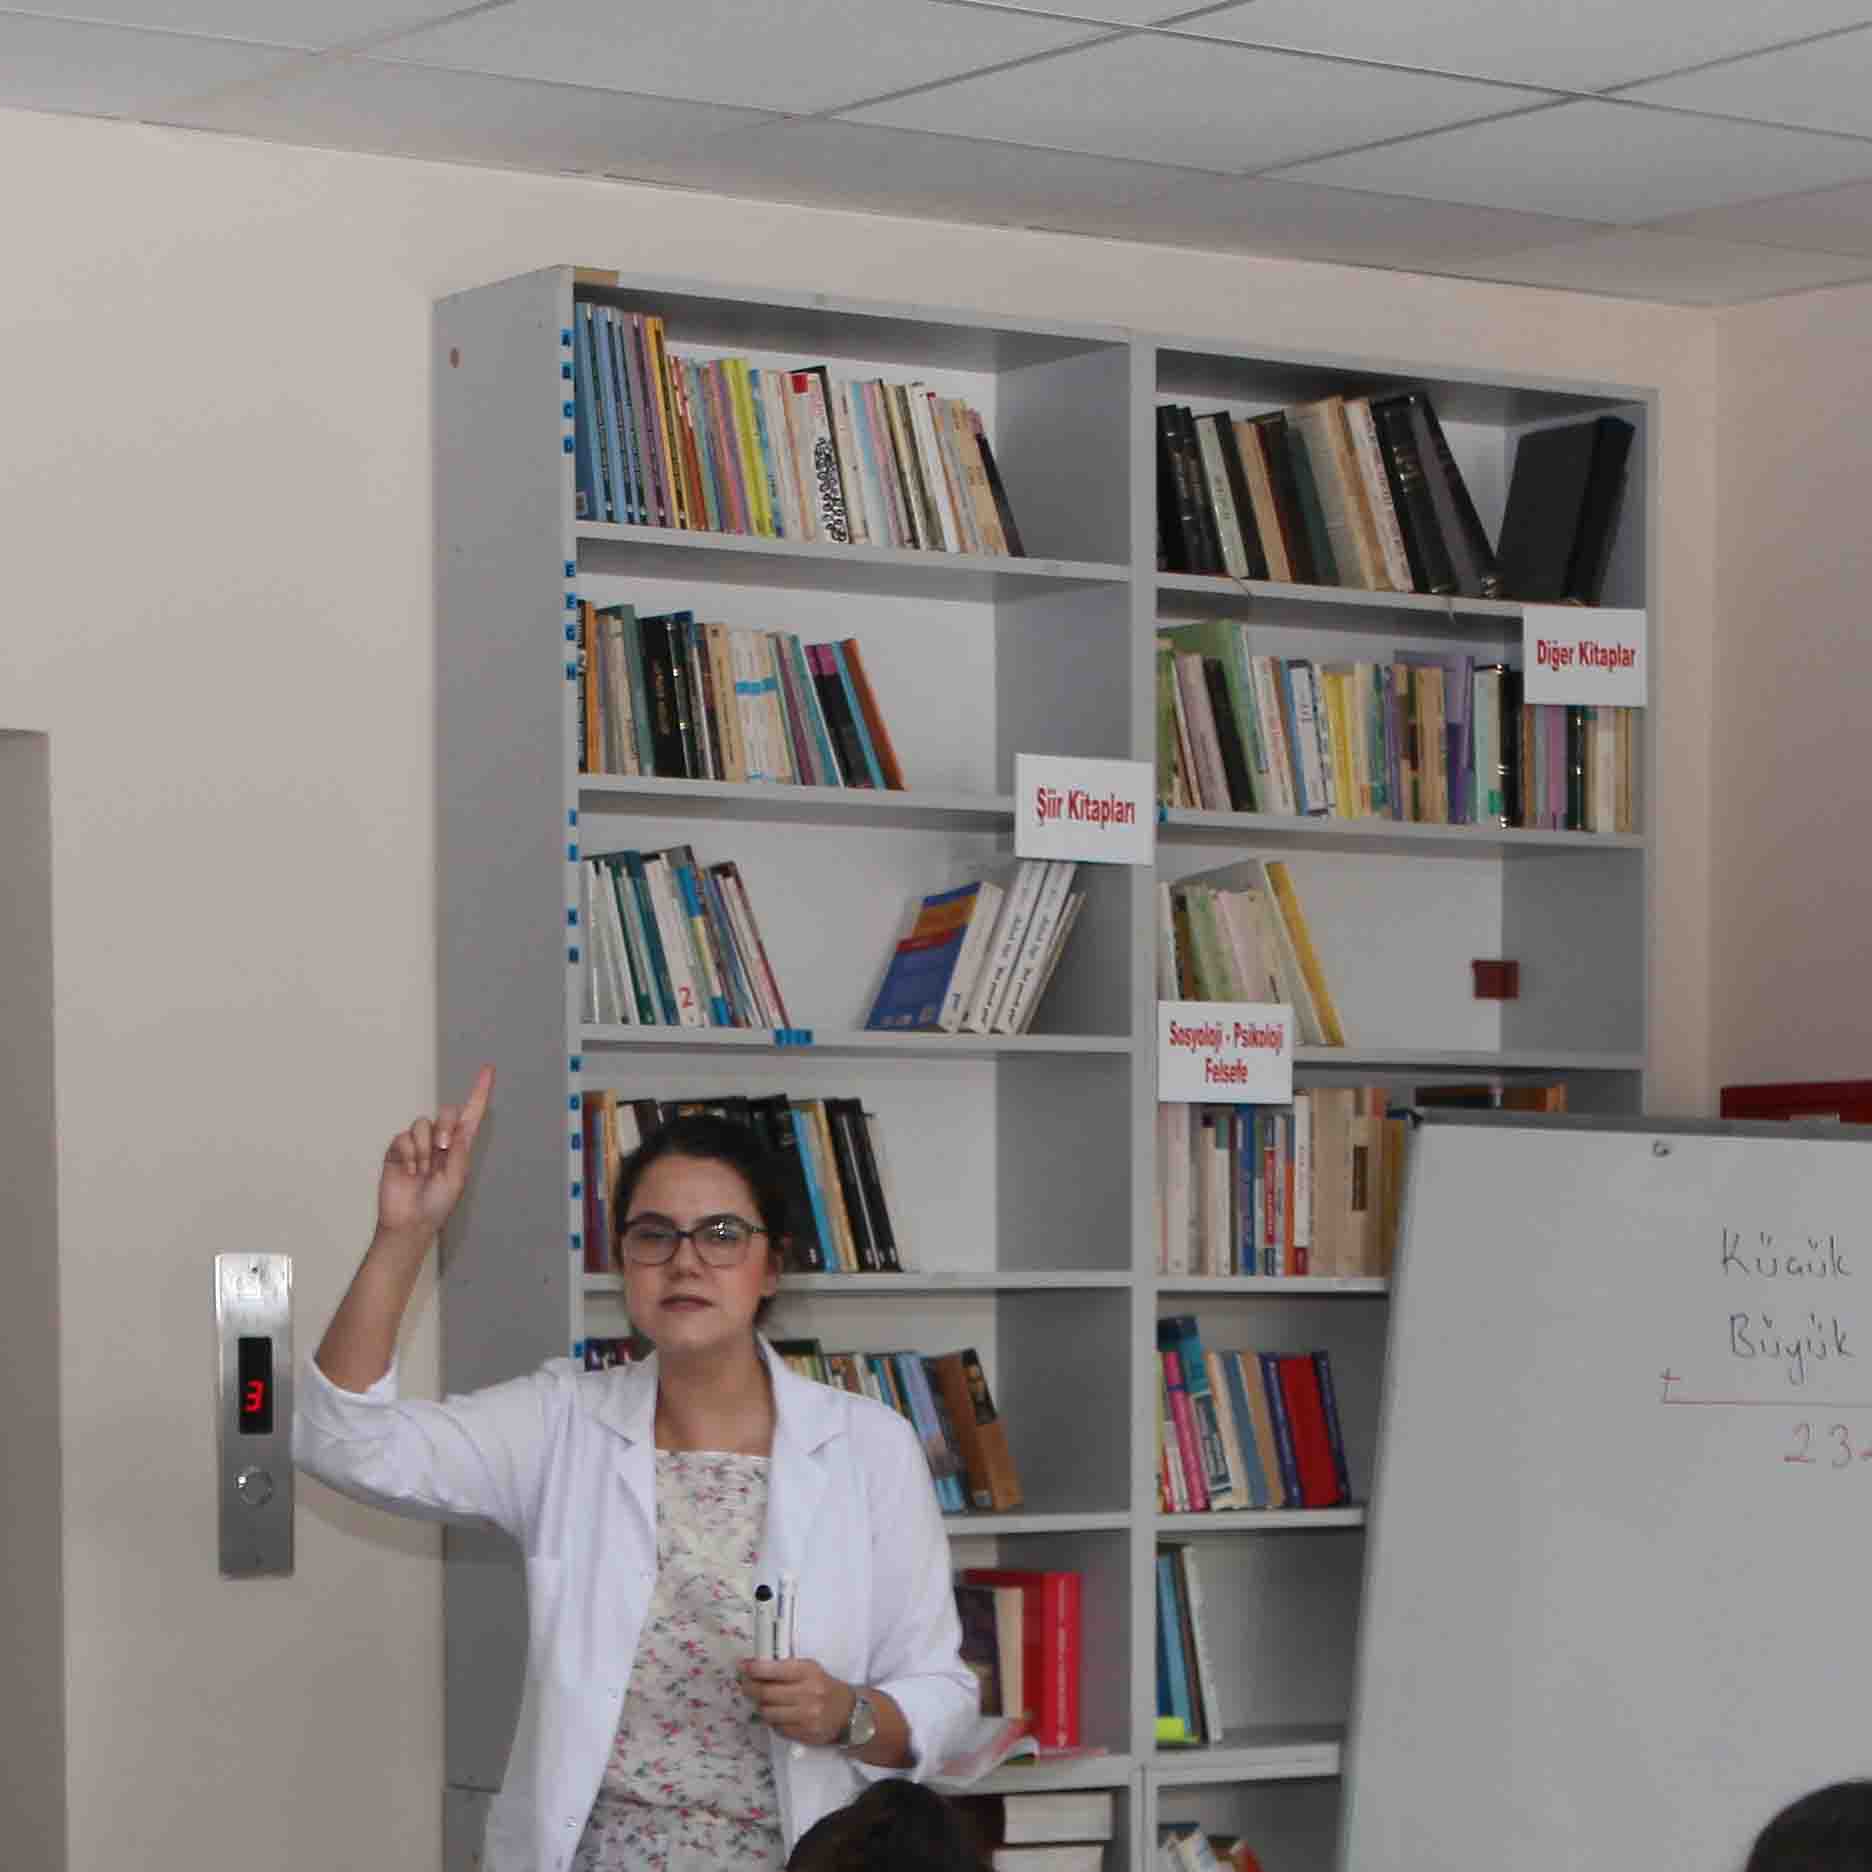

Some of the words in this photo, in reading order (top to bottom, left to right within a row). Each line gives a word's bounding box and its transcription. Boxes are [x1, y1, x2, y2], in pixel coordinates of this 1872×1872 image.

[1536, 639, 1574, 672] Diğer
[1579, 640, 1636, 673] Kitaplar
[1037, 787, 1063, 826] Şiir
[1069, 789, 1136, 830] Kitapları
[1205, 1056, 1249, 1084] Felsefe
[1728, 1311, 1856, 1386] Büyük
[244, 1379, 265, 1414] 3
